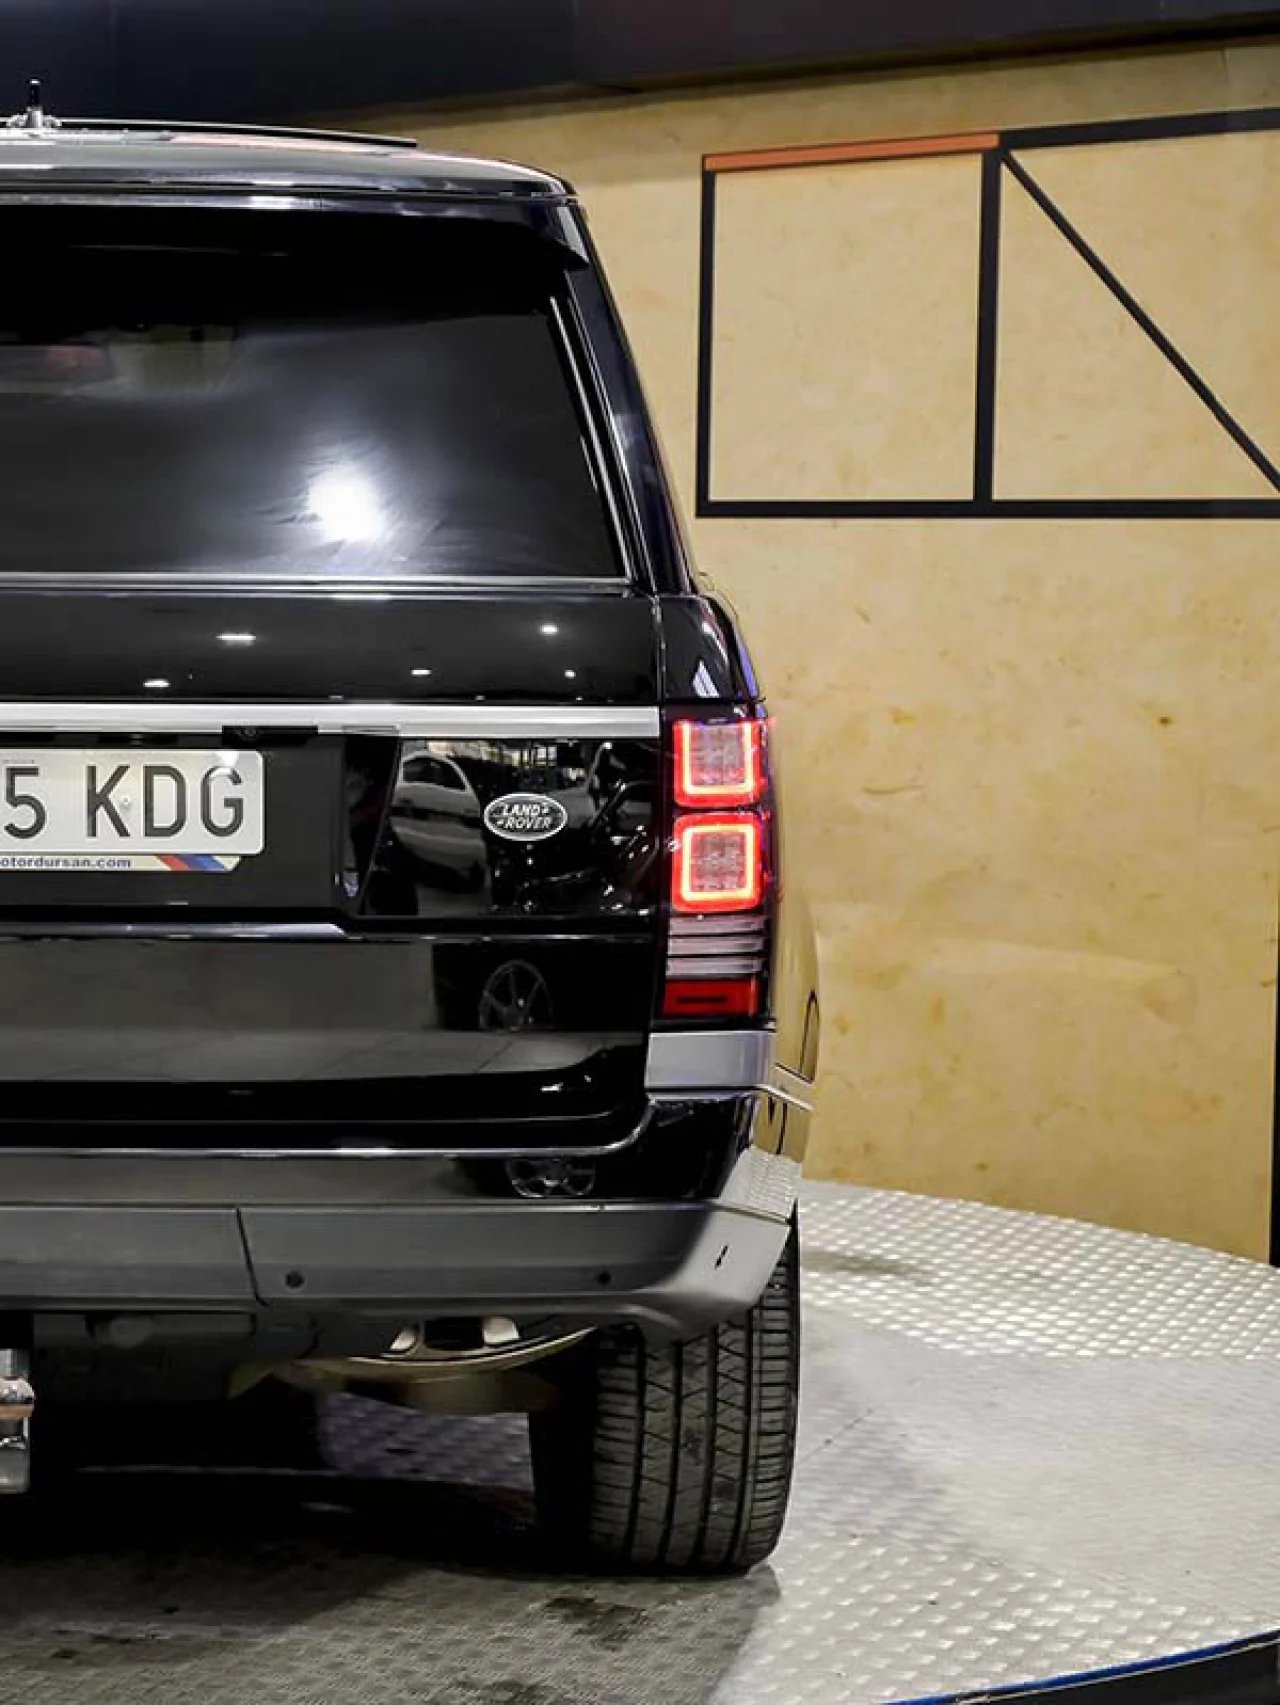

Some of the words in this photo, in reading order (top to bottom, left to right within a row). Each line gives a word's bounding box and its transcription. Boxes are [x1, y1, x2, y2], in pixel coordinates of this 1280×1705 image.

[86, 765, 244, 838] KDG
[502, 803, 541, 816] LAND
[504, 816, 552, 829] ROVER
